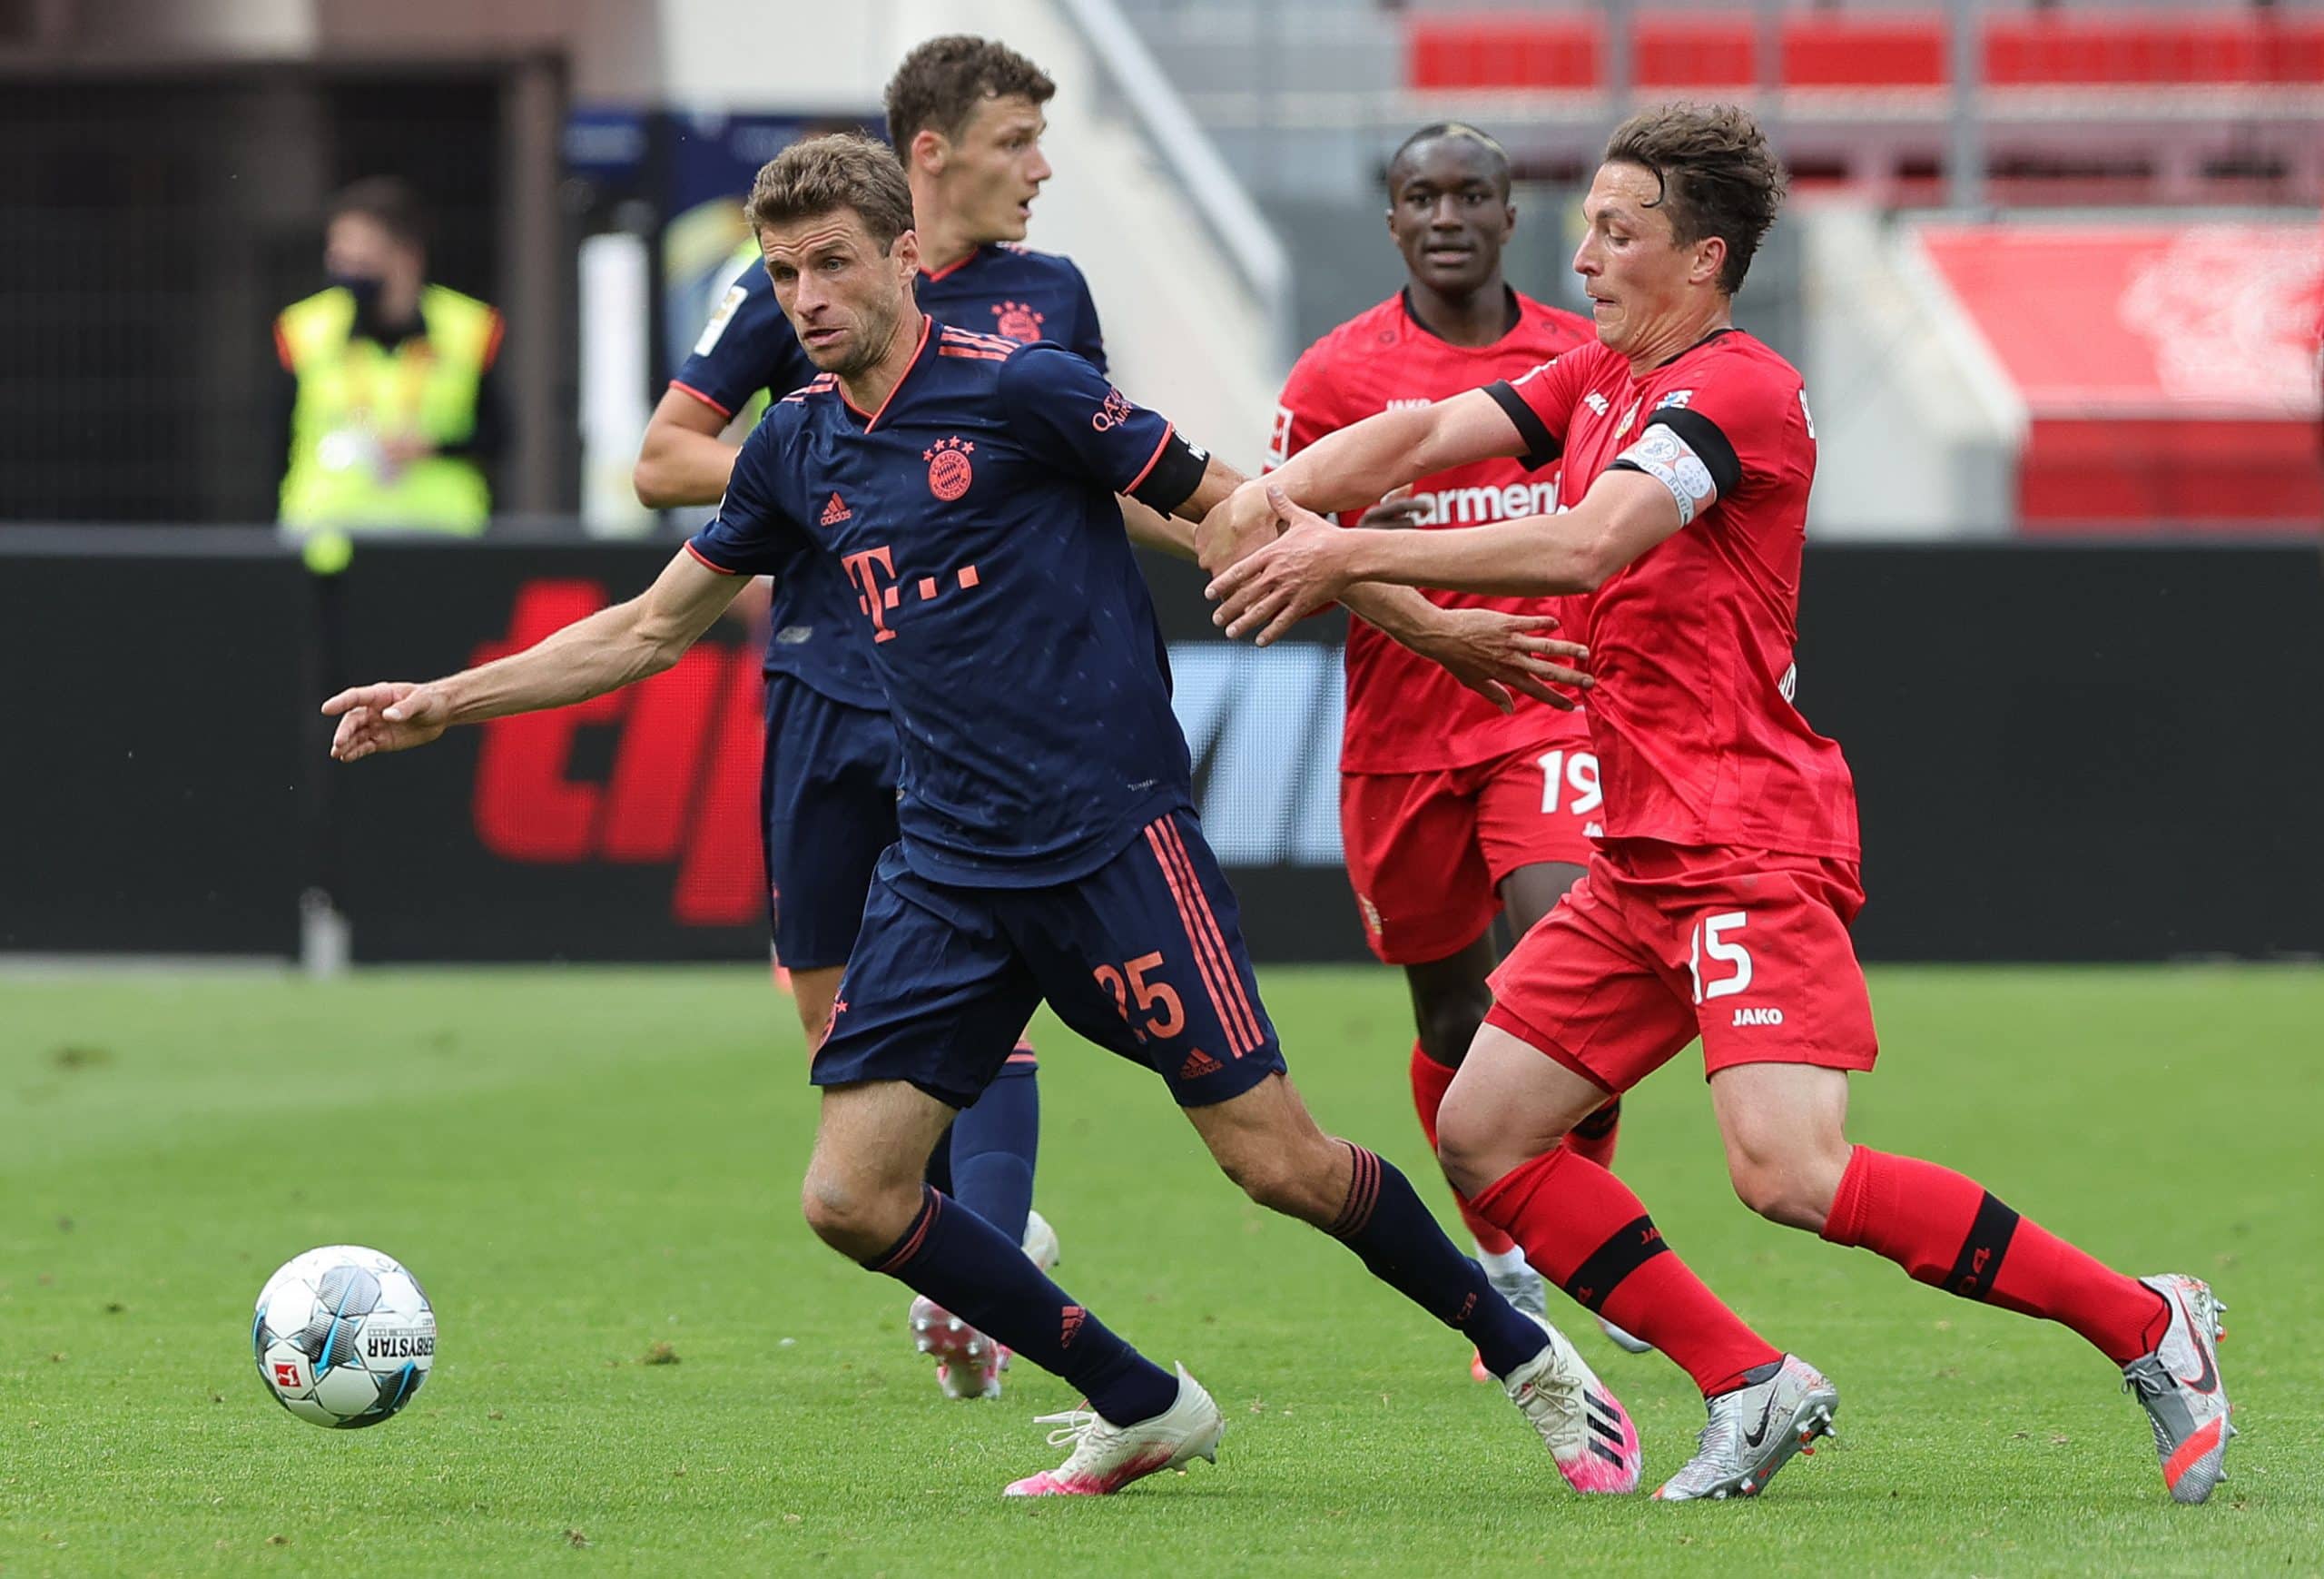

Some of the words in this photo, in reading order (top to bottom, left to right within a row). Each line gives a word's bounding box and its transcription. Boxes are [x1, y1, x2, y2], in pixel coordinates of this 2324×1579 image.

[820, 508, 853, 527] adidas
[1536, 749, 1603, 815] 19
[1092, 951, 1186, 1043] 25
[1731, 1007, 1784, 1027] JAKO
[367, 1337, 436, 1358] ERBYSTAR
